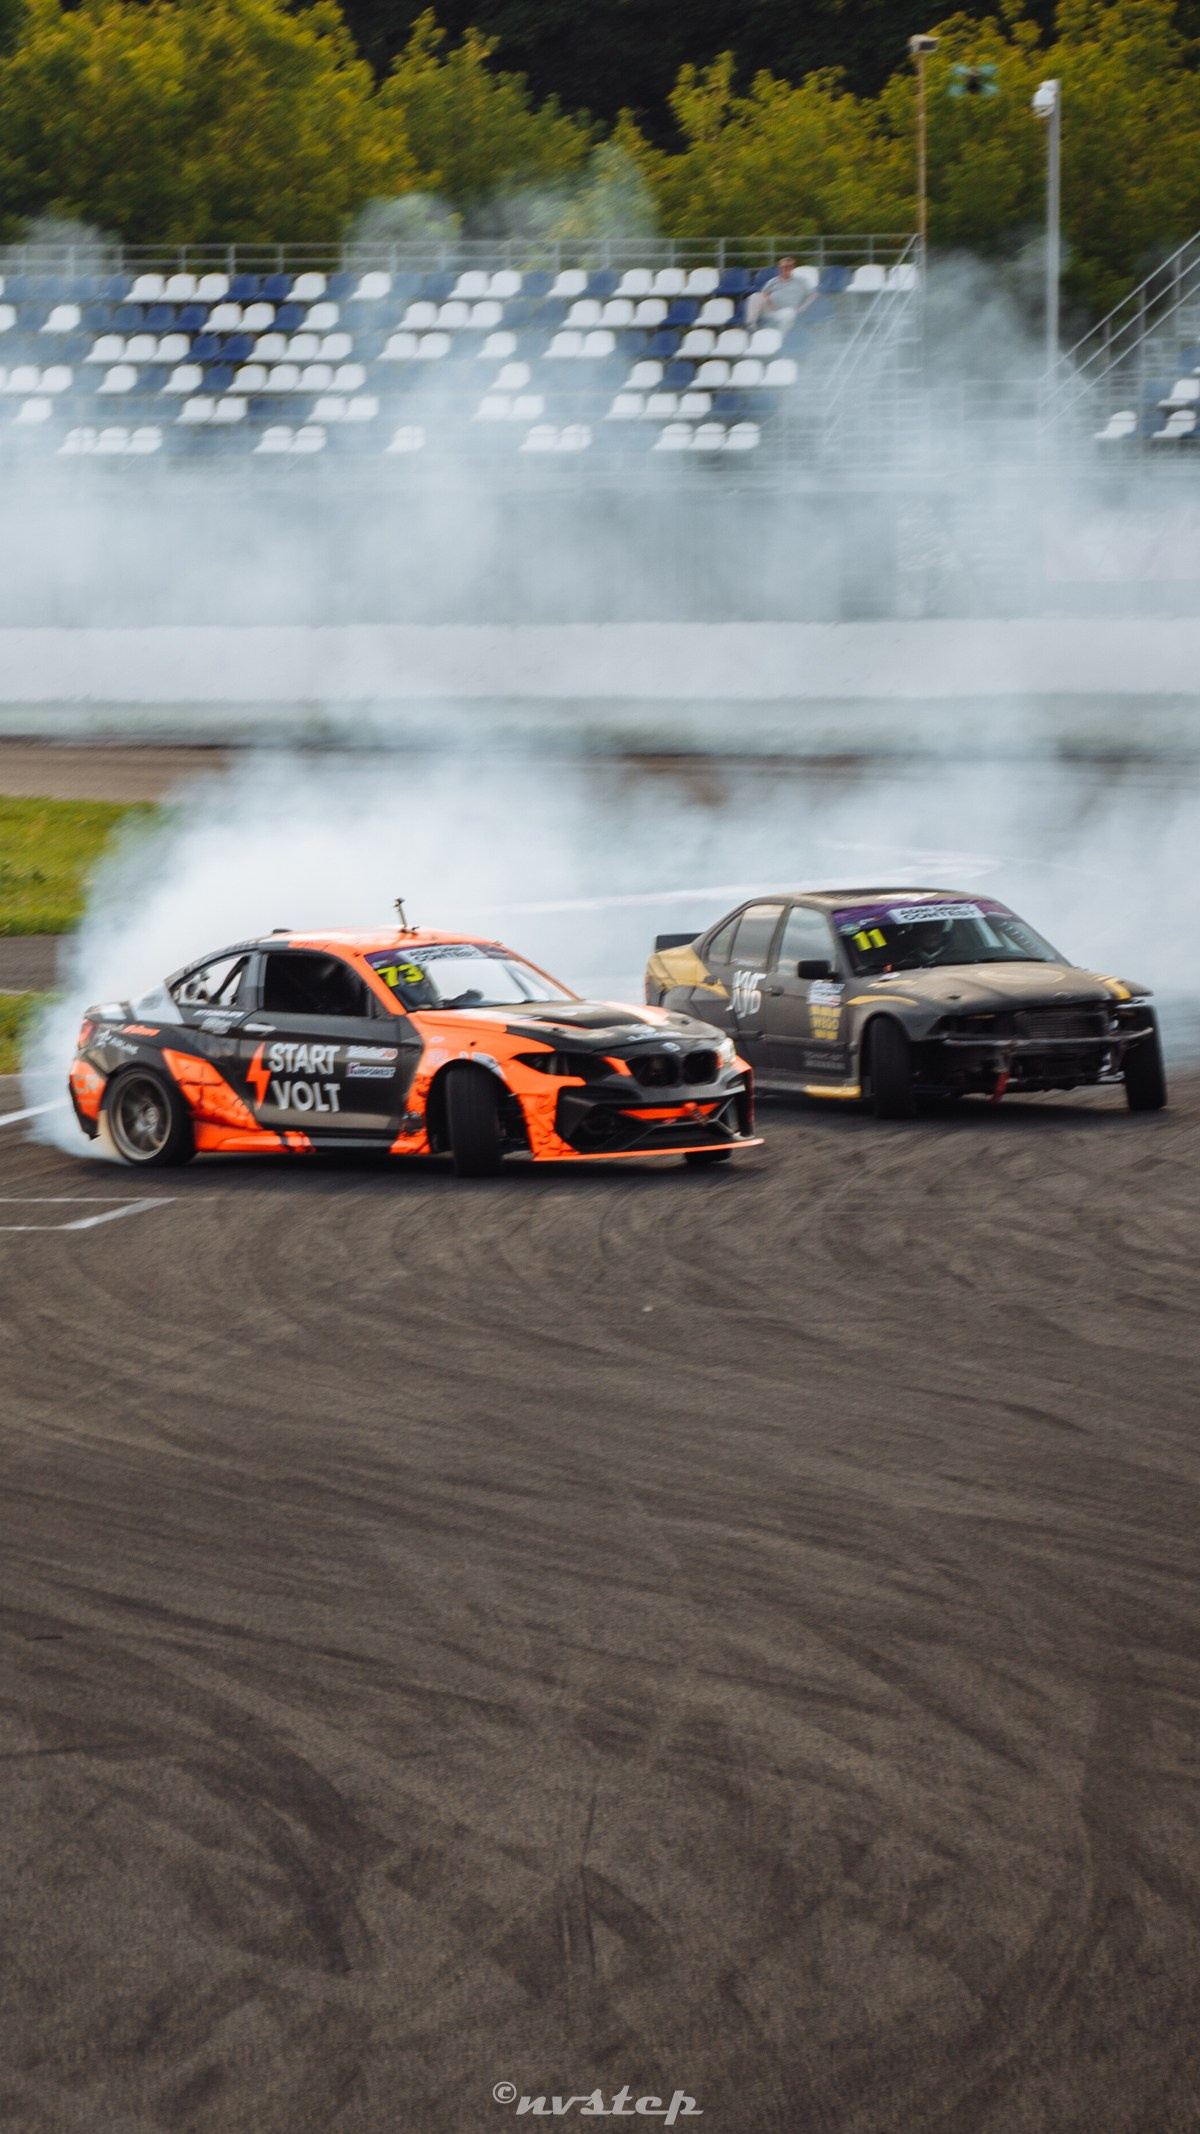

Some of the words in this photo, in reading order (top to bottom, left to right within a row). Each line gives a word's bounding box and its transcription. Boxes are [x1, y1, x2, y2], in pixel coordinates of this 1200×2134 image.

[852, 928, 887, 951] 11
[376, 963, 424, 987] 73
[268, 1042, 341, 1075] START
[271, 1080, 341, 1113] VOLT
